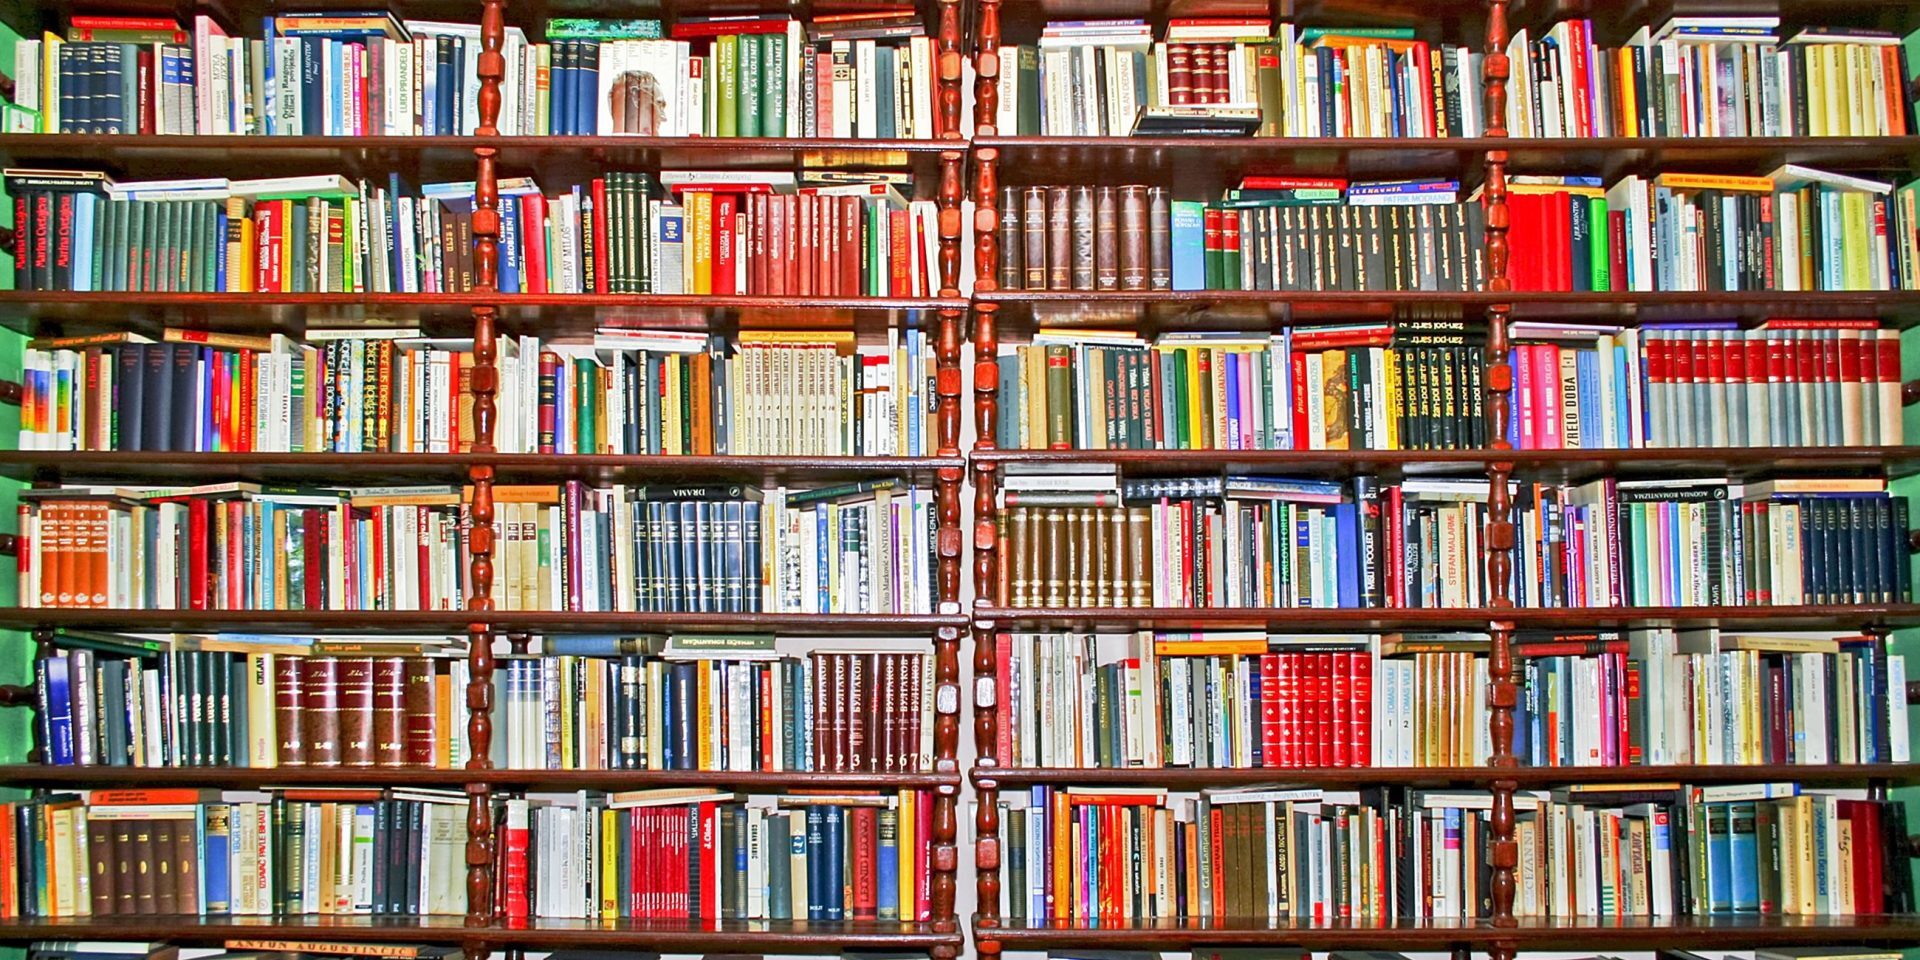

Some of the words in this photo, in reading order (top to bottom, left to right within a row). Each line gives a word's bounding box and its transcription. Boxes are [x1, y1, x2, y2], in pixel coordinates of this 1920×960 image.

[505, 199, 513, 212] UM
[507, 215, 515, 267] ZAROBLJENI
[1564, 377, 1576, 406] DOBA
[1565, 413, 1579, 446] ZRELO
[1447, 514, 1455, 553] MALARME
[1448, 555, 1456, 585] STEFAN
[1403, 687, 1411, 715] TOMAS
[232, 834, 240, 855] TIBOR
[1815, 808, 1825, 853] matvejević
[859, 862, 869, 902] LEONID
[1816, 856, 1828, 896] predrag
[236, 940, 287, 949] ANTUN
